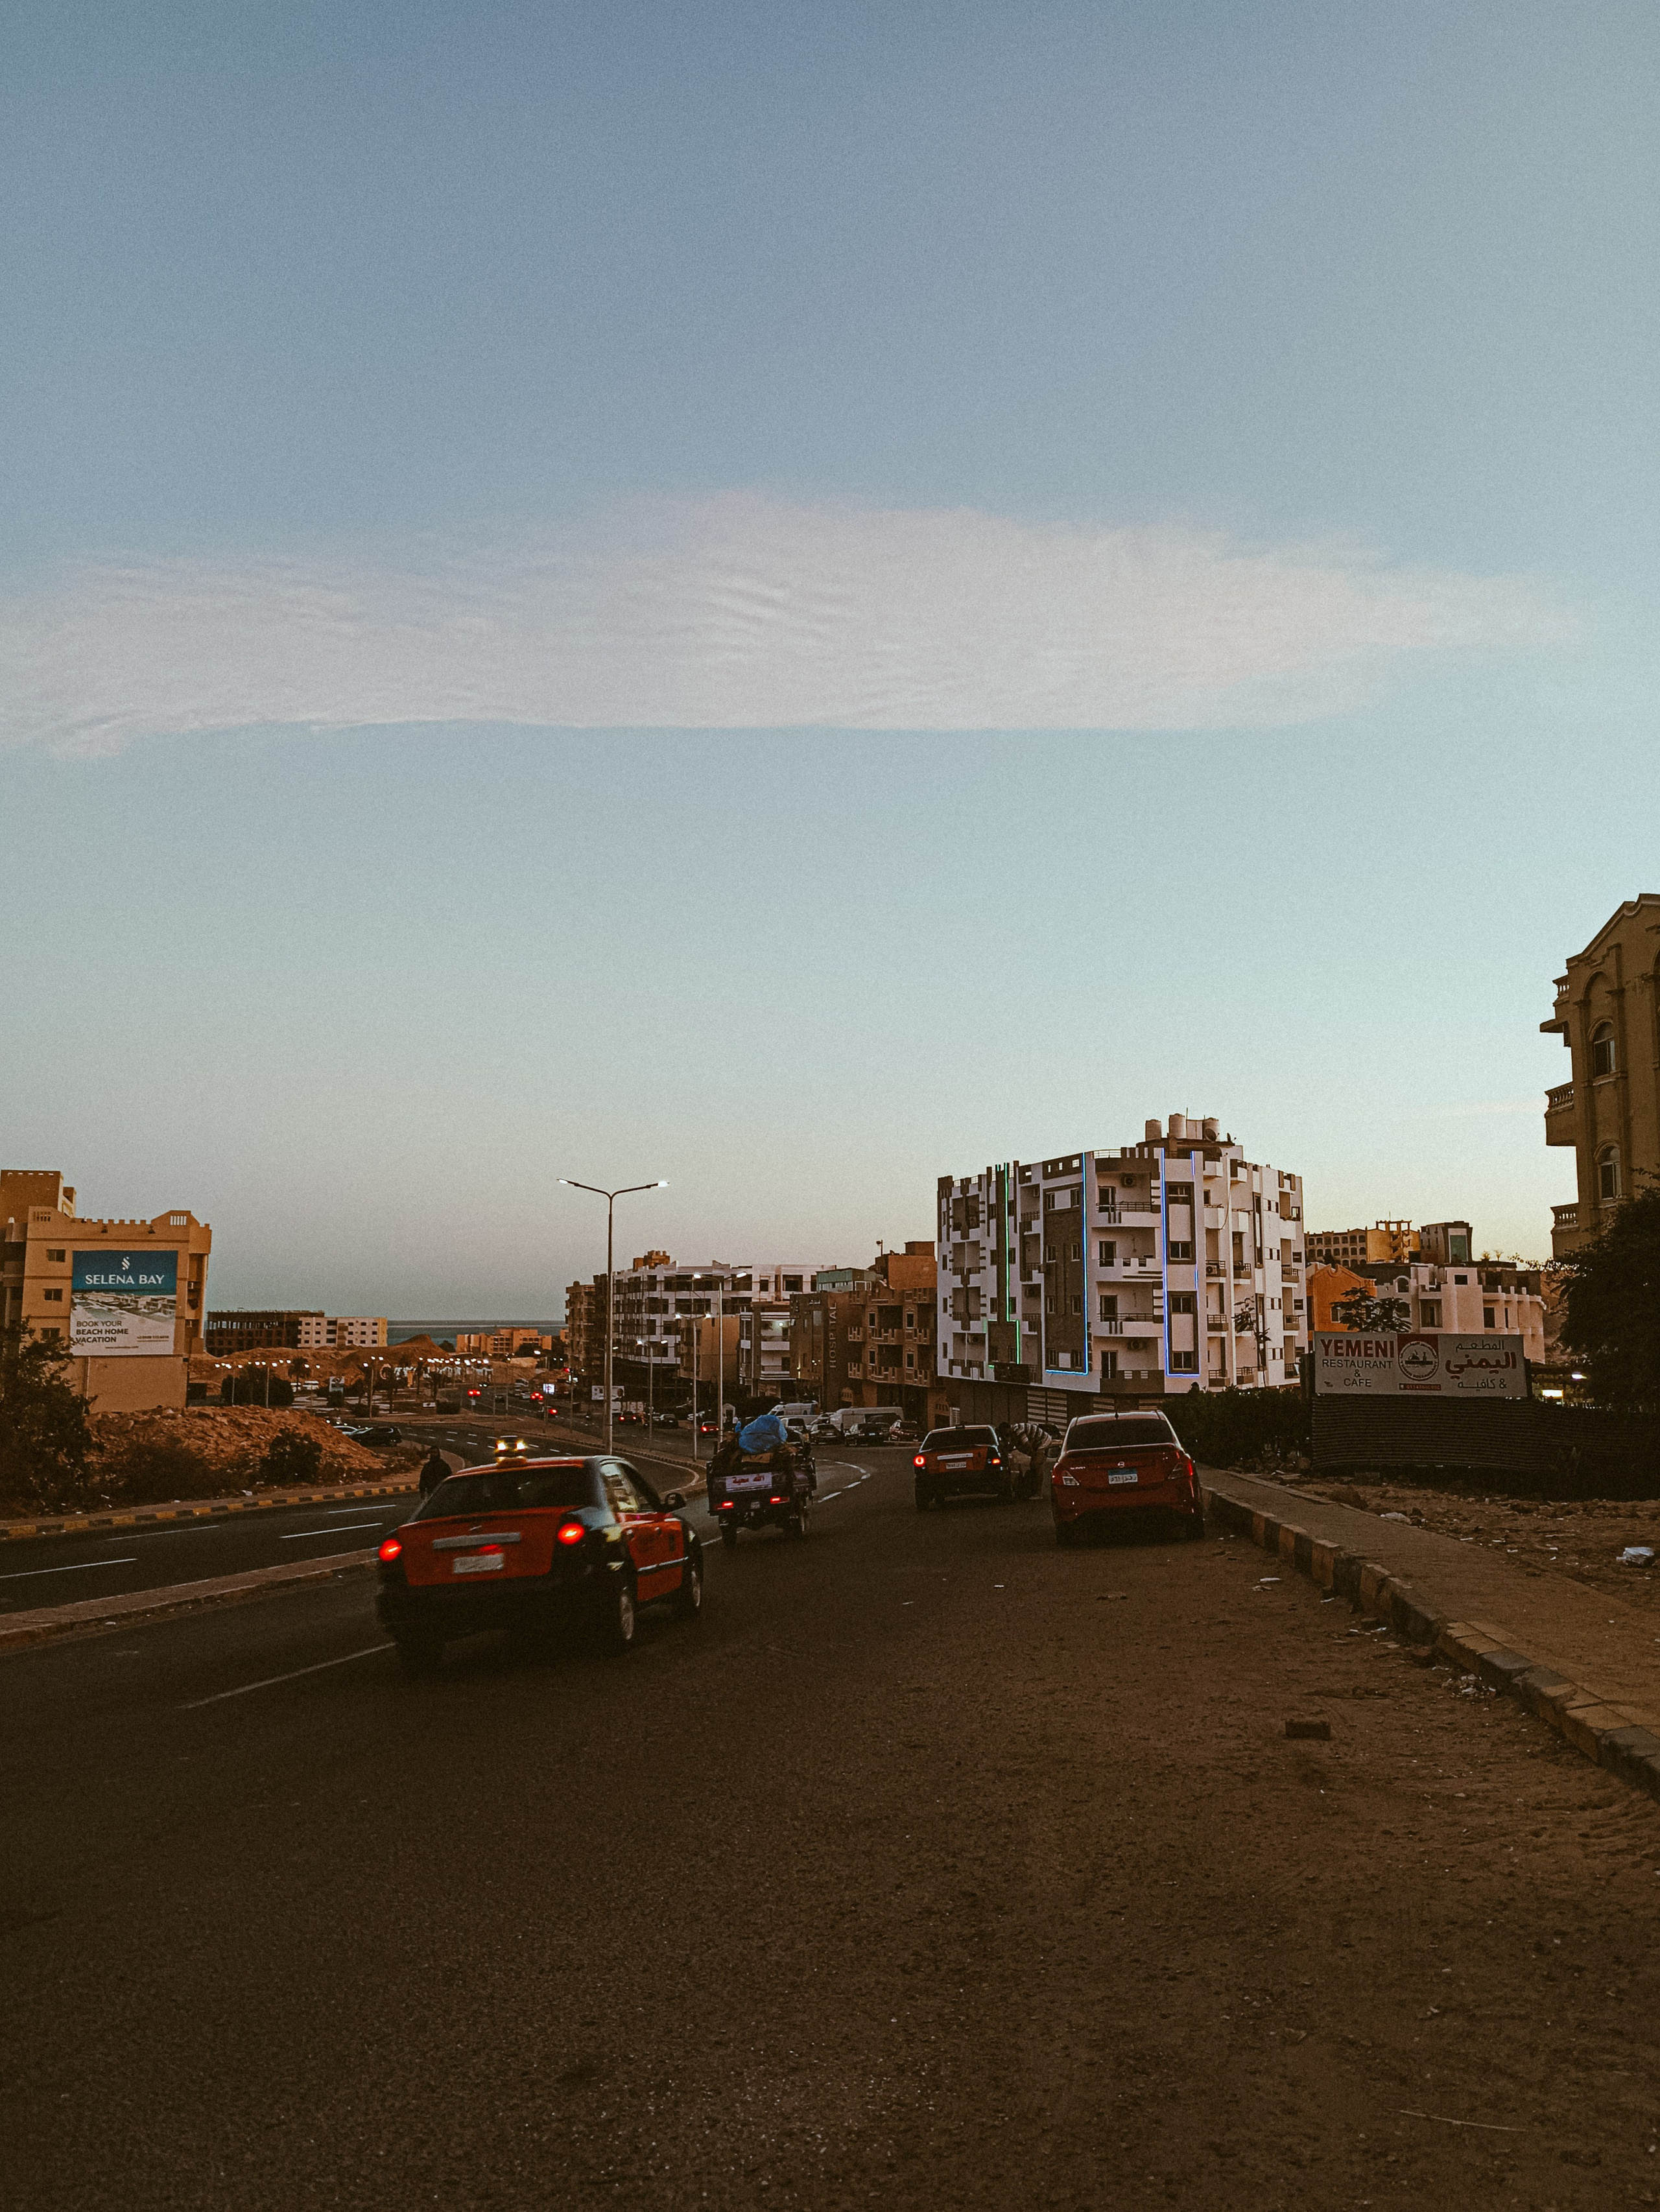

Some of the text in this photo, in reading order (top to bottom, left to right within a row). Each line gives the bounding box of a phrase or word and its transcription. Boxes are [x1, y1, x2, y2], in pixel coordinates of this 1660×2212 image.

[85, 1274, 165, 1285] SELENA BAY
[829, 1302, 837, 1369] HOSPITAL
[1320, 1339, 1395, 1358] YEMENI
[1455, 1339, 1505, 1352] المطعم
[1322, 1359, 1393, 1369] RESTAURANT
[1445, 1351, 1517, 1380] اليمني
[1354, 1369, 1361, 1378] &
[1344, 1378, 1372, 1387] CAFE
[1457, 1378, 1507, 1391] & كافيه
